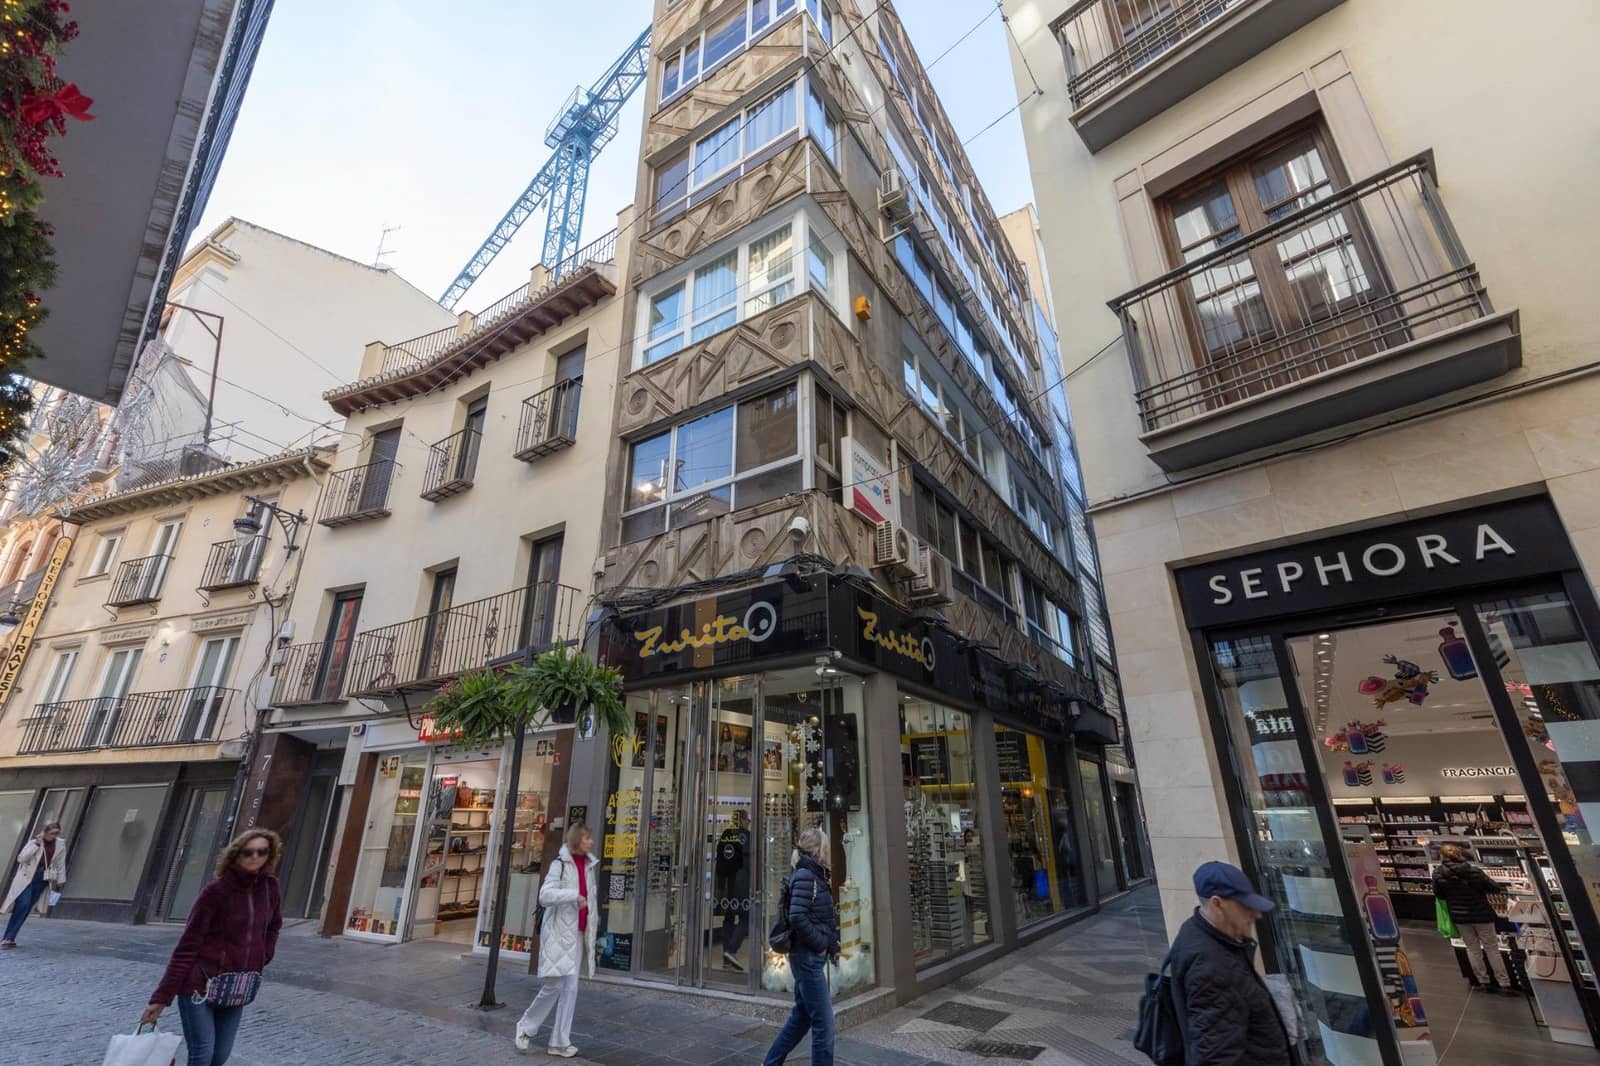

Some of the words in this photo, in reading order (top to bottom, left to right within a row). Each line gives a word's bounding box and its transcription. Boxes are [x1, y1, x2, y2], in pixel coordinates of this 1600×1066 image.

[1208, 523, 1517, 605] SEPHORA
[25, 557, 61, 628] GESTORIA
[635, 614, 756, 657] Zurita
[857, 605, 927, 664] Zurita
[262, 754, 273, 771] 7
[1442, 766, 1516, 777] FRAGANCIA
